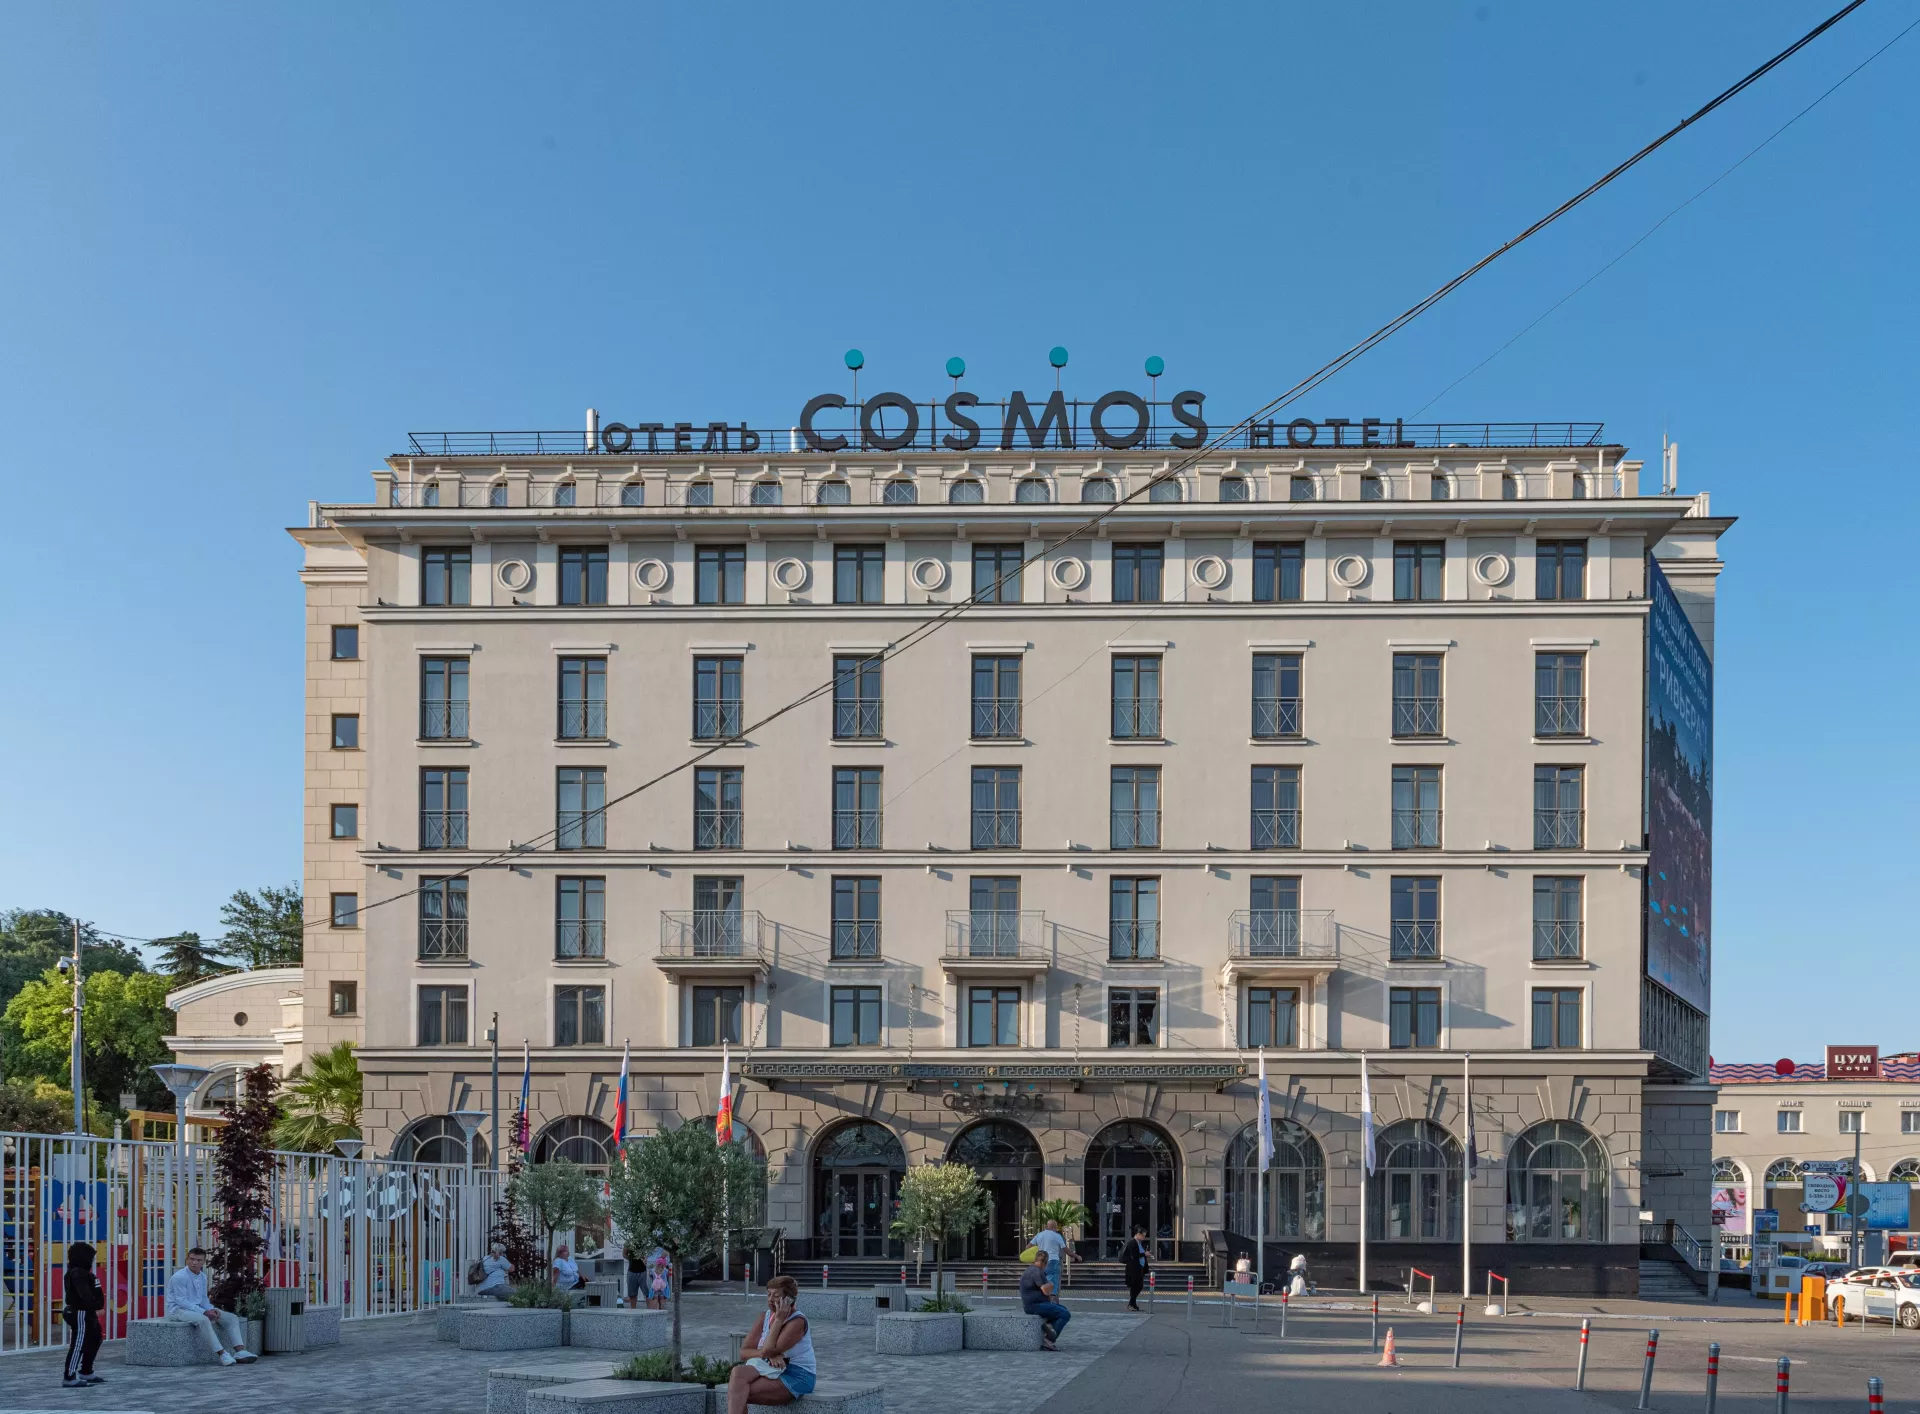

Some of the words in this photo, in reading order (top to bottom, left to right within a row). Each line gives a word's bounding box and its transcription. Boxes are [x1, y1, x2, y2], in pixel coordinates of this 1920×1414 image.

[799, 391, 1209, 451] COSMOS
[1250, 418, 1416, 449] HOTEL
[602, 422, 761, 452] ОТЕЛЬ
[1834, 1054, 1872, 1065] ЦУМ
